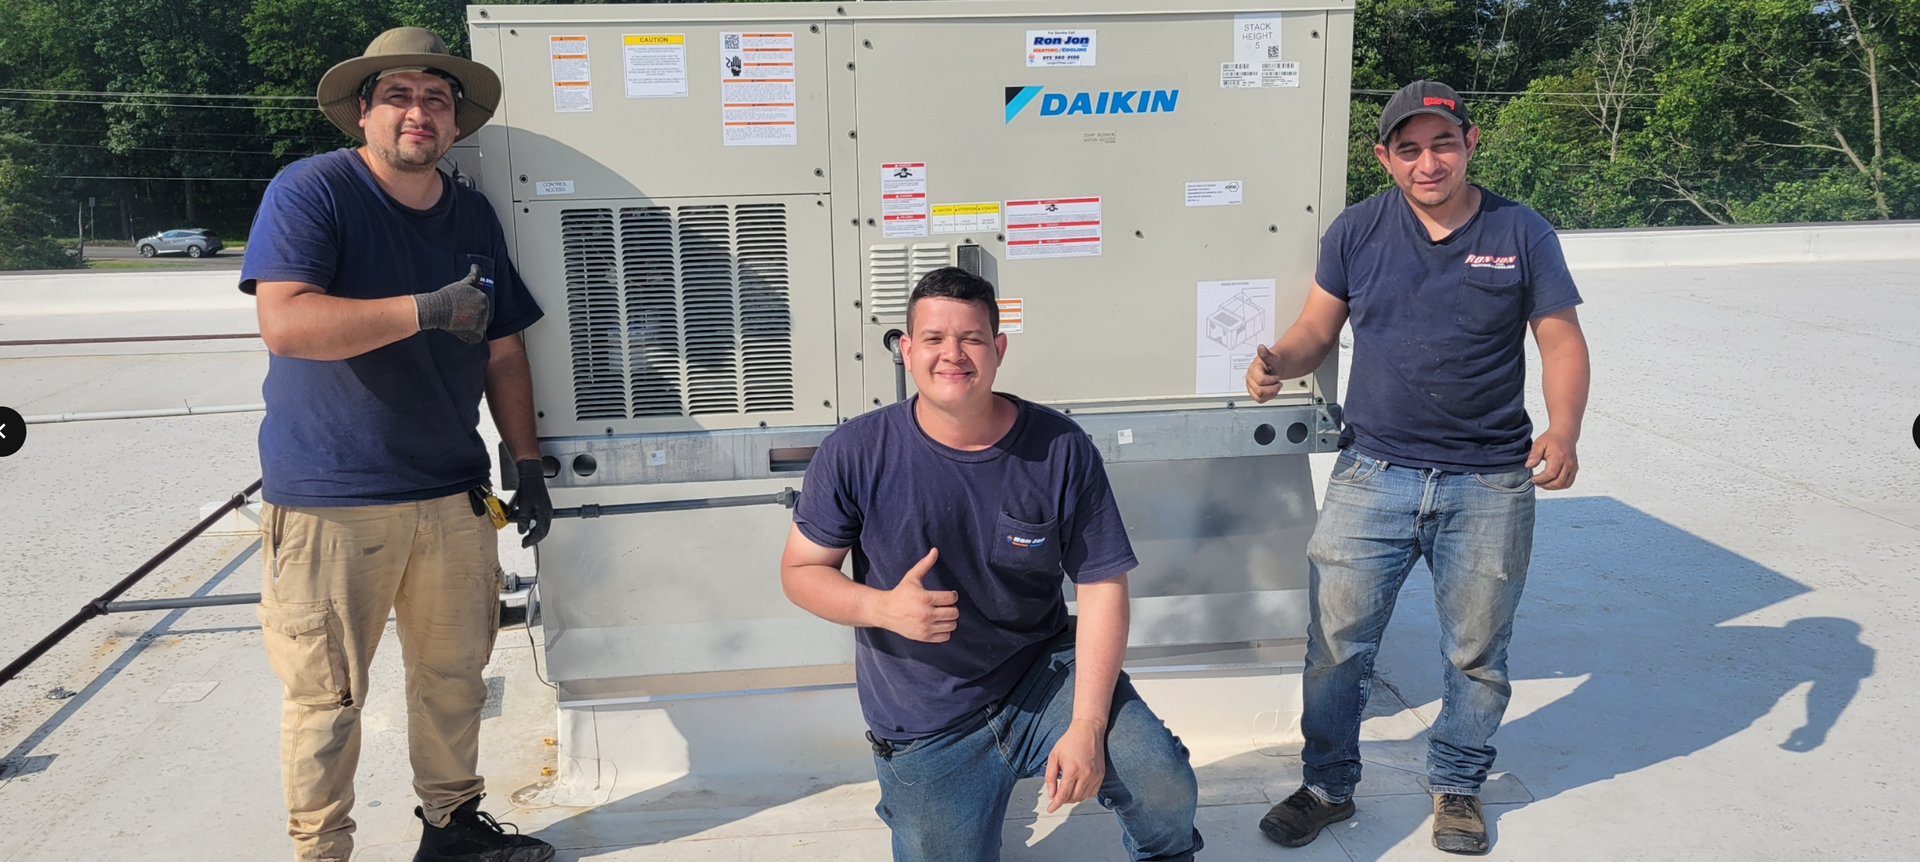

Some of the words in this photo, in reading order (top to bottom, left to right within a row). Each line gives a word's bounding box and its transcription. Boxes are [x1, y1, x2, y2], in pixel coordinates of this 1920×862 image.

[1244, 23, 1271, 31] STACK
[1033, 36, 1062, 46] Ron
[1064, 36, 1089, 45] Jon
[1242, 32, 1273, 41] HEIGHT
[1040, 90, 1179, 116] DAIKIN
[1464, 254, 1492, 264] RON
[1493, 256, 1516, 264] JON
